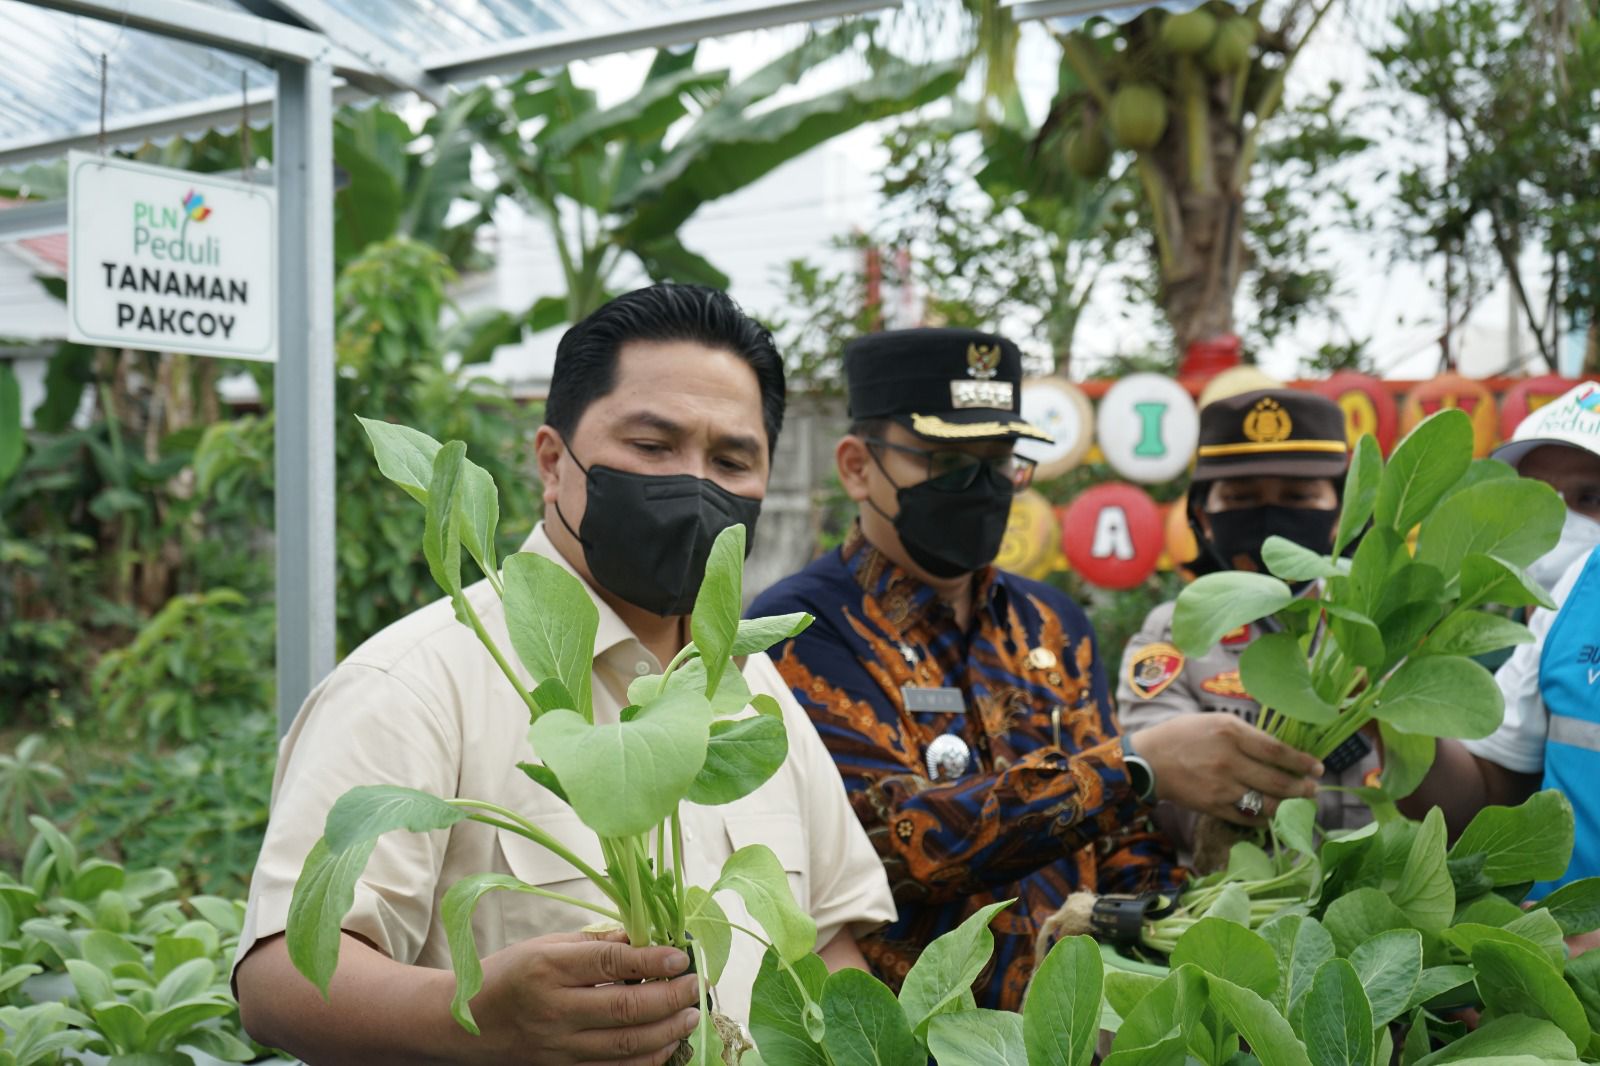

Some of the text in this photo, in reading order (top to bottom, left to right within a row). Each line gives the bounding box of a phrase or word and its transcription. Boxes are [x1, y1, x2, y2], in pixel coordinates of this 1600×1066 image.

[134, 202, 177, 230] PLN
[134, 225, 221, 266] Peduli
[102, 262, 248, 305] TANAMAN
[117, 303, 235, 339] PAKCOY
[1133, 402, 1168, 457] I
[1090, 505, 1135, 561] A
